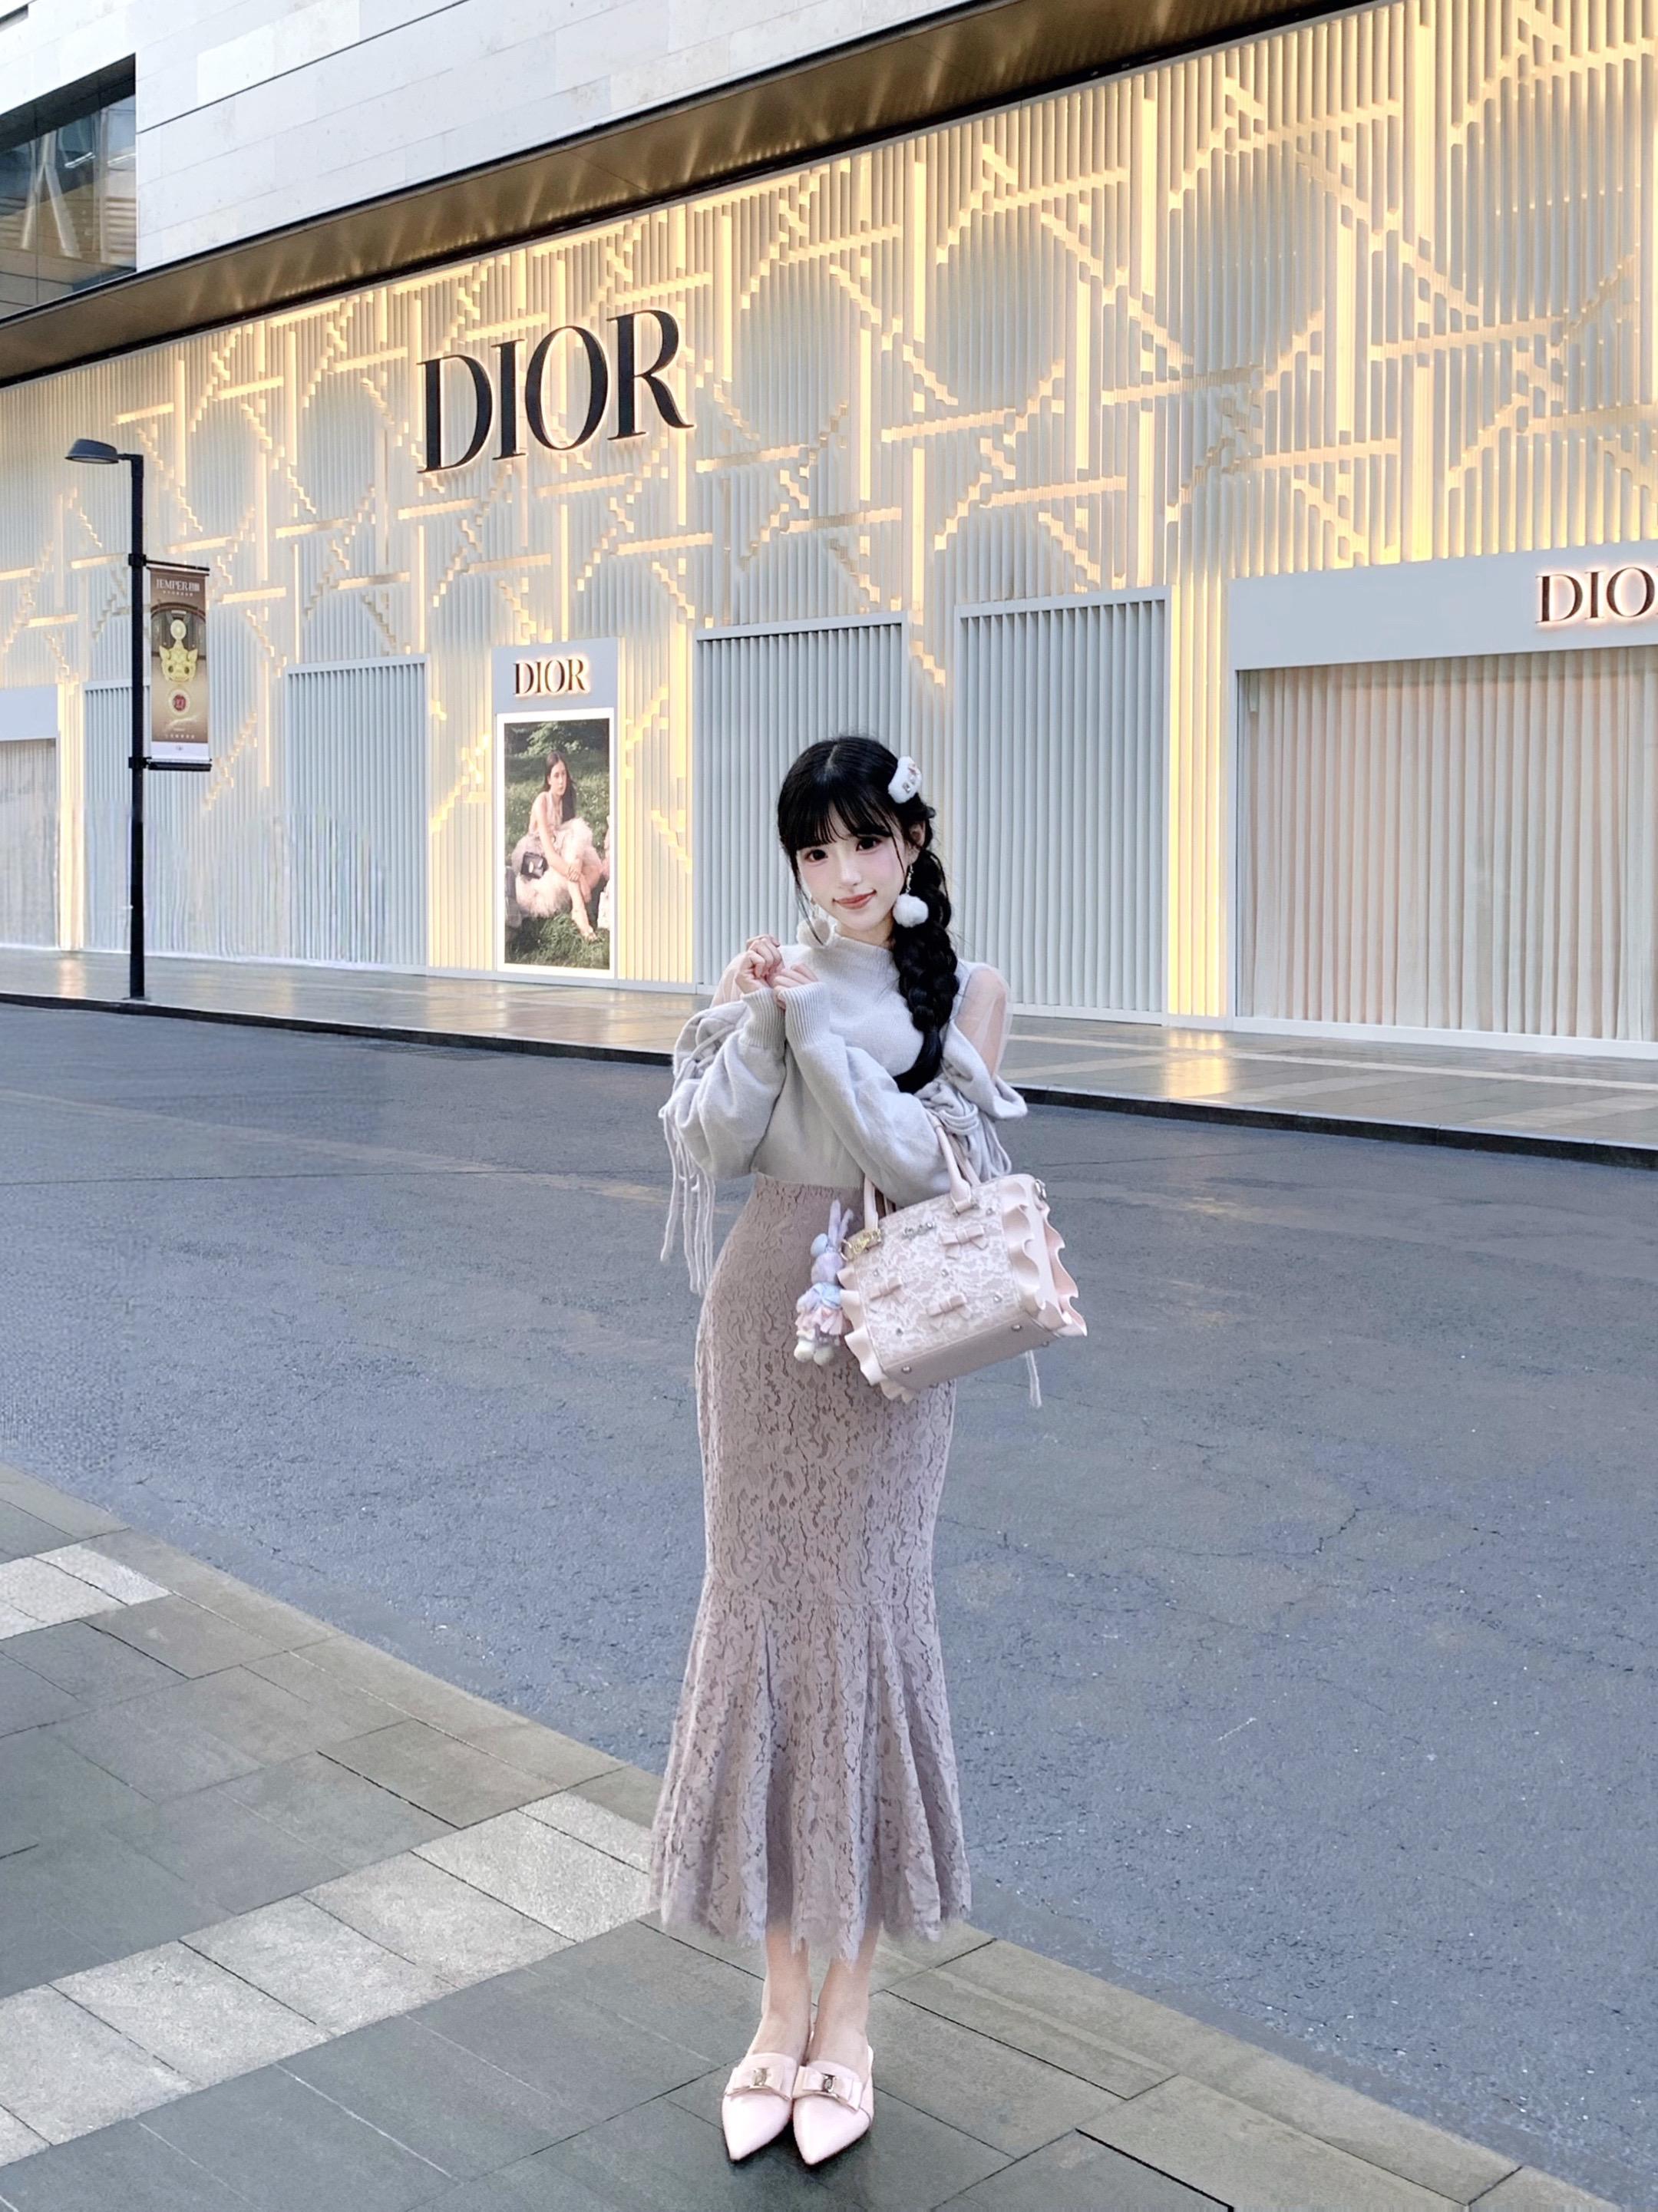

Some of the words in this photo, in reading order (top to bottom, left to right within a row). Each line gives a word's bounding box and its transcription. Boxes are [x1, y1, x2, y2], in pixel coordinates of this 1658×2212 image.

[417, 309, 695, 473] DIOR
[1535, 566, 1658, 623] DIO
[513, 659, 586, 695] DIOR
